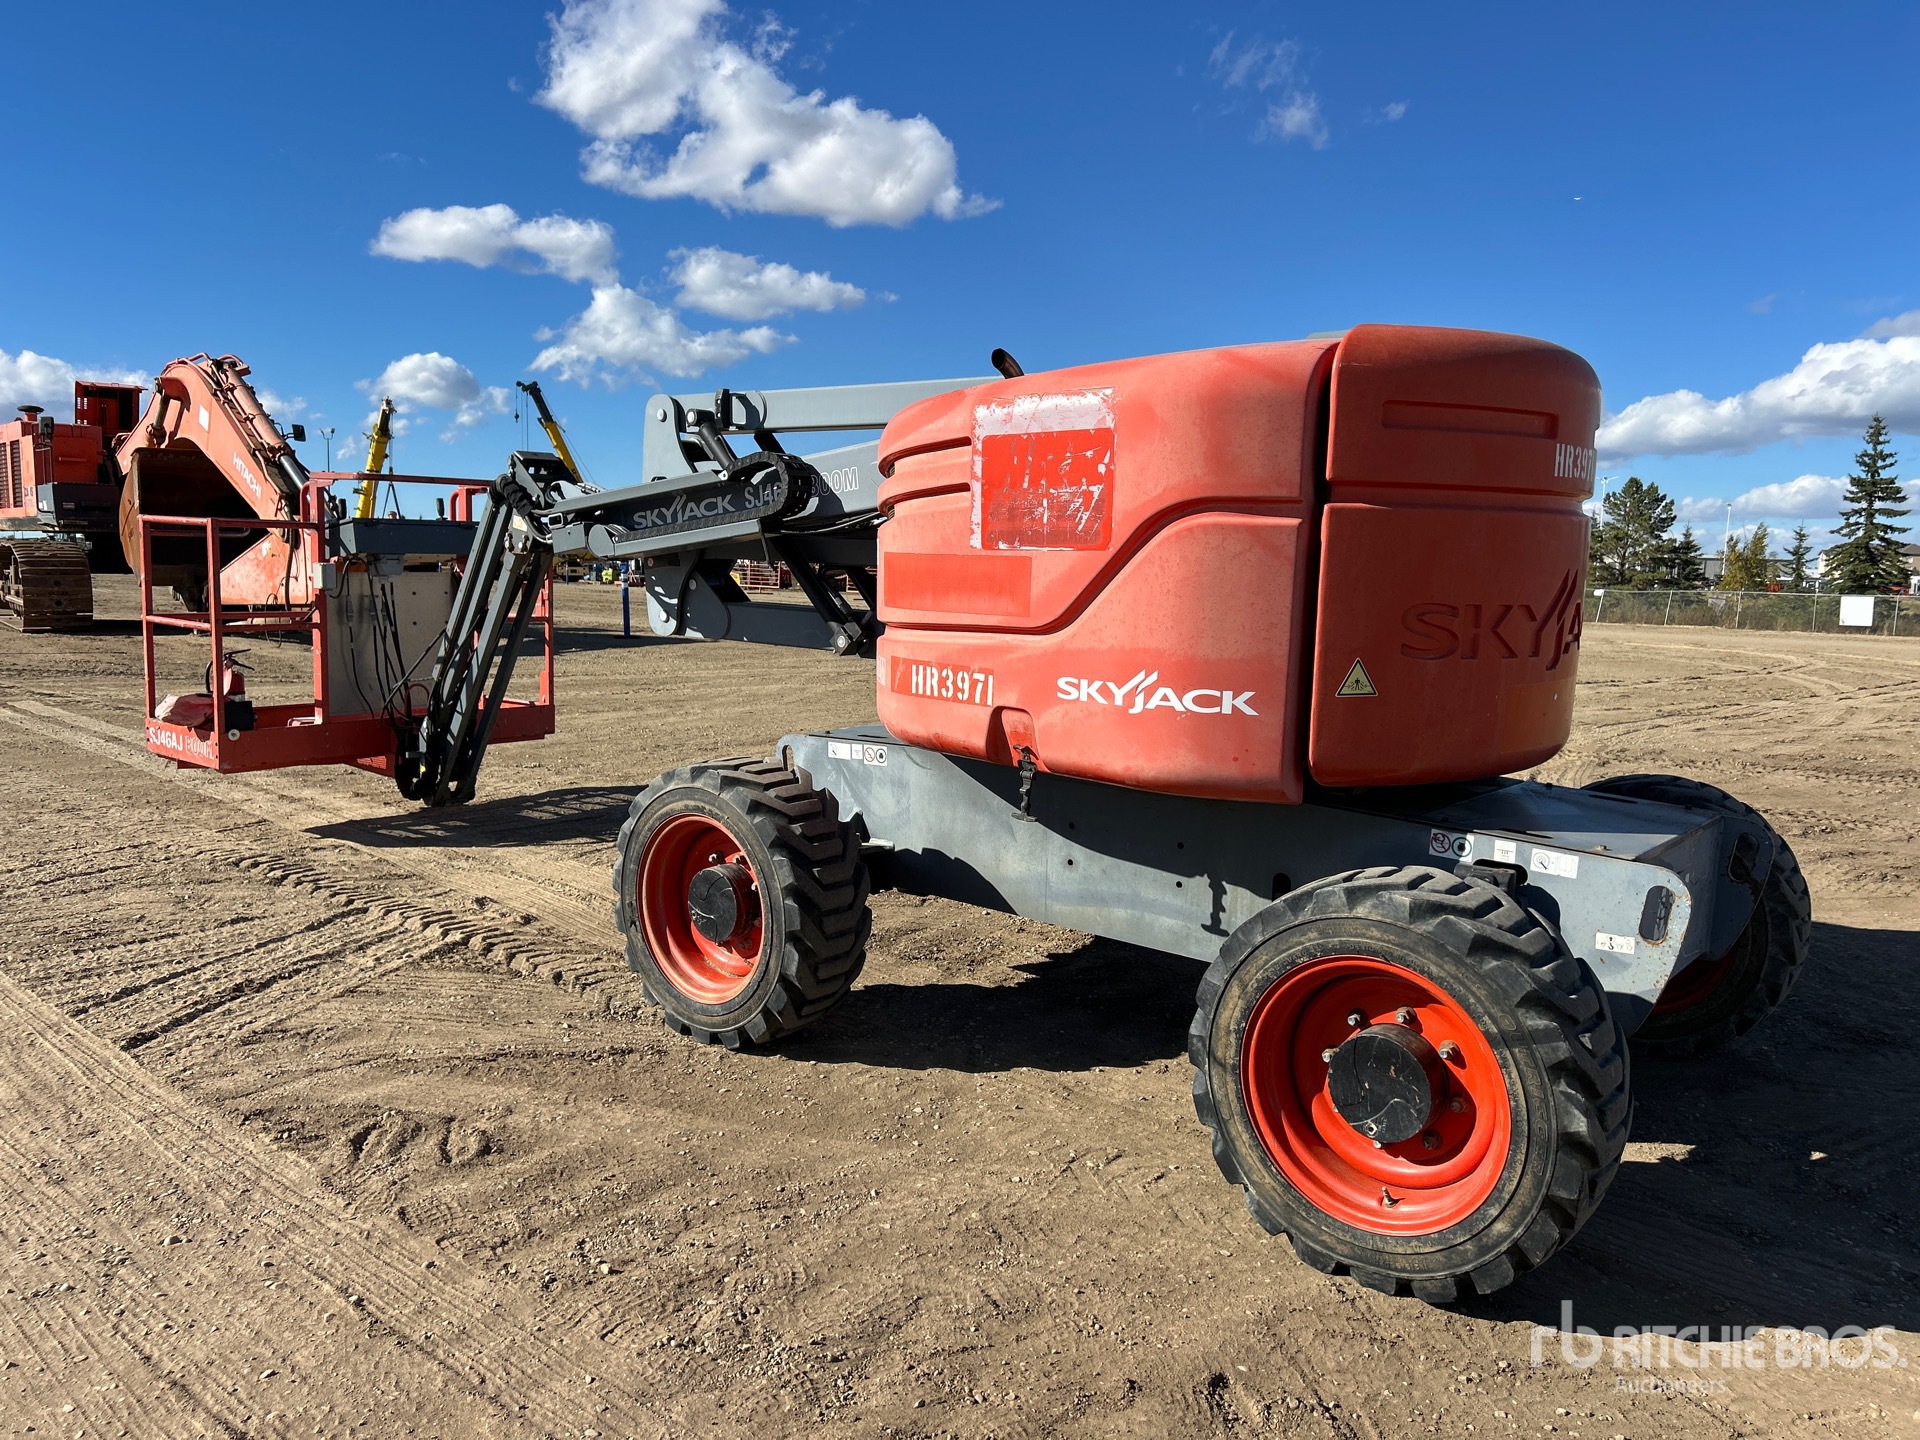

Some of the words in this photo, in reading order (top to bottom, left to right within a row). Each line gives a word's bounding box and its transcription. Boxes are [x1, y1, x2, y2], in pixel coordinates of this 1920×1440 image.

[232, 451, 262, 500] HITACHI
[633, 494, 737, 530] SKYJACK
[810, 467, 859, 498] BOOM
[911, 664, 994, 706] HR3971
[1057, 669, 1260, 716] SKYJACK
[149, 727, 183, 751] SJ46AJ
